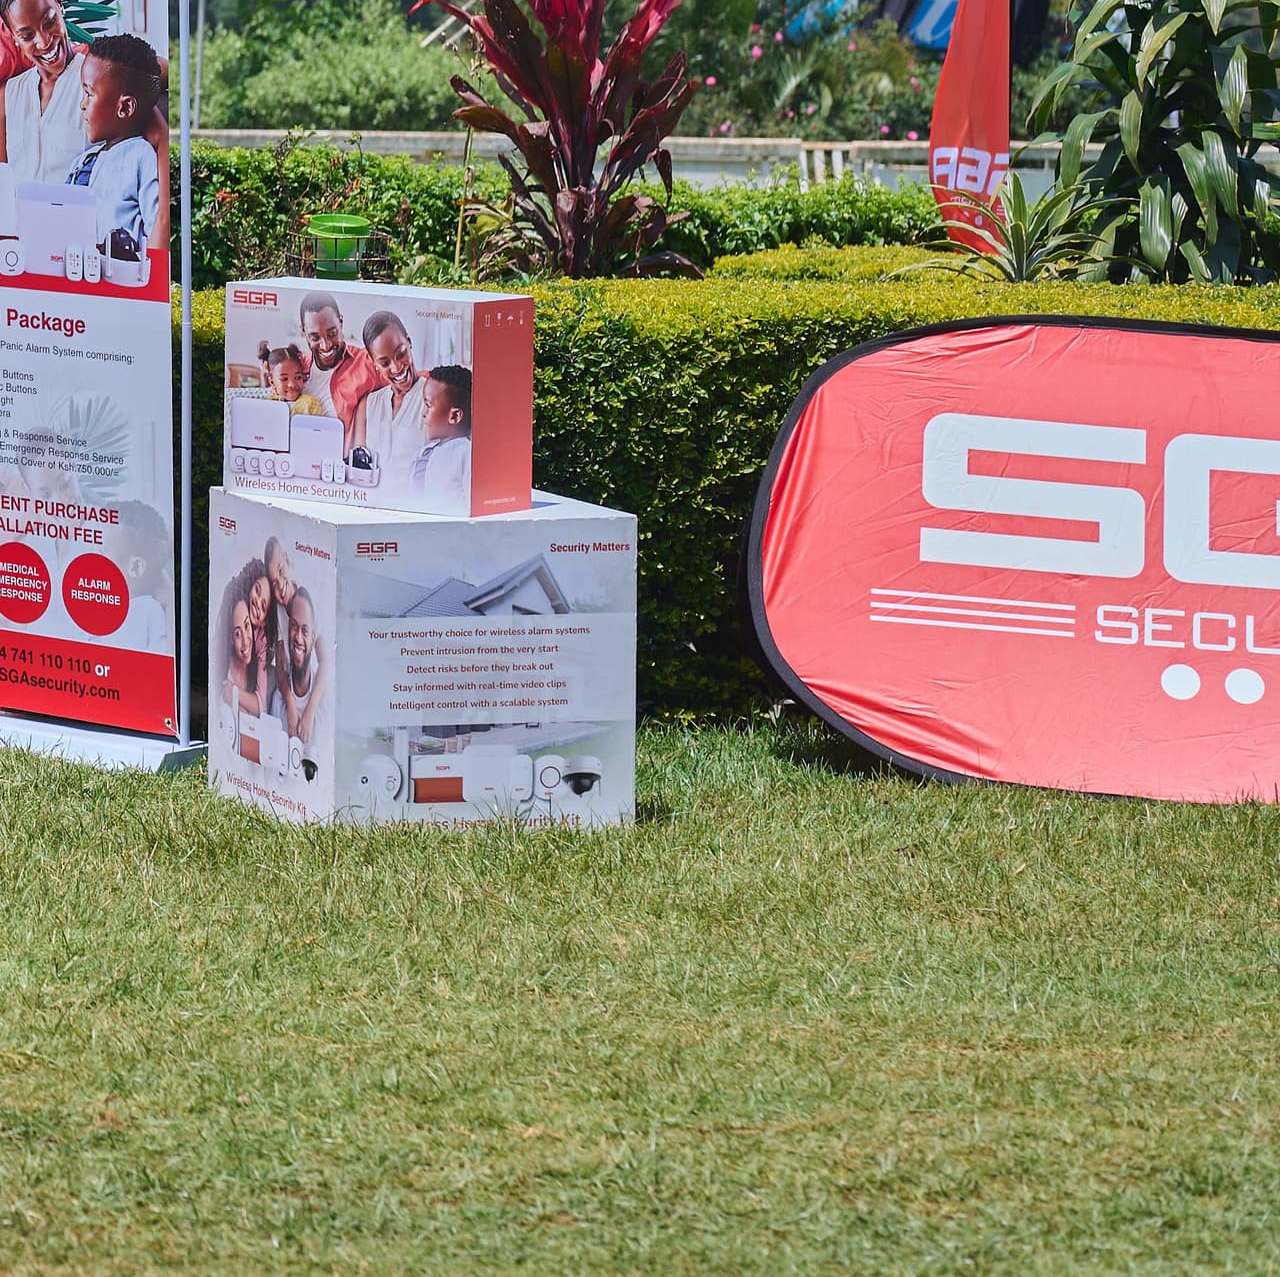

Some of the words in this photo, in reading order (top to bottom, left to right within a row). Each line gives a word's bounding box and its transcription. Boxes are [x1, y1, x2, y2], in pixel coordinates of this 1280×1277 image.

[234, 290, 278, 306] SGA
[6, 308, 86, 337] Package
[0, 340, 24, 352] Panic
[26, 342, 50, 354] Alarm
[52, 346, 84, 360] System
[86, 350, 135, 365] comprising:
[2, 369, 34, 382] Buttons
[6, 383, 38, 395] Buttons
[12, 429, 54, 444] Response
[56, 434, 88, 448] Service
[0, 441, 46, 457] Emergency
[48, 446, 90, 462] Response
[92, 452, 124, 466] Service
[21, 457, 46, 469] Cover
[48, 460, 56, 470] of
[234, 476, 276, 491] Wireless
[278, 482, 309, 496] Home
[310, 484, 351, 502] Security
[354, 488, 368, 502] Kit
[34, 500, 120, 525] PURCHASE
[219, 516, 237, 530] SGA
[74, 527, 103, 545] FEE
[356, 542, 398, 554] SGA
[550, 542, 590, 554] Security
[592, 542, 630, 552] Matters
[0, 562, 40, 577] MEDICAL
[78, 578, 111, 591] ALARM
[70, 589, 121, 606] RESPONSE
[368, 630, 388, 640] Your
[390, 628, 443, 640] trustworthy
[445, 628, 472, 637] choice
[474, 628, 488, 636] for
[489, 626, 526, 636] wireless
[528, 626, 553, 636] alarm
[554, 626, 590, 637] systems
[400, 647, 434, 656] Prevent
[436, 646, 475, 656] intrusion
[477, 646, 498, 655] from
[500, 645, 514, 654] the
[516, 646, 536, 656] very
[538, 644, 559, 654] start
[11, 648, 34, 664] 741
[39, 653, 63, 670] 110
[67, 657, 90, 674] 110
[95, 663, 111, 677] or
[406, 664, 436, 674] Detect
[438, 664, 458, 674] risks
[460, 663, 488, 673] before
[491, 662, 510, 674] they
[512, 662, 537, 672] break
[539, 662, 554, 672] out
[393, 683, 412, 694] Stay
[414, 681, 454, 692] informed
[456, 681, 476, 690] with
[478, 680, 518, 690] real-time
[520, 680, 544, 689] video
[546, 679, 566, 691] clips
[389, 701, 435, 712] Intelligent
[436, 700, 468, 710] control
[470, 699, 490, 708] with
[500, 698, 536, 708] scalable
[538, 698, 568, 709] system
[226, 770, 252, 793] Wireless
[253, 782, 270, 800] Home
[272, 790, 296, 812] Security
